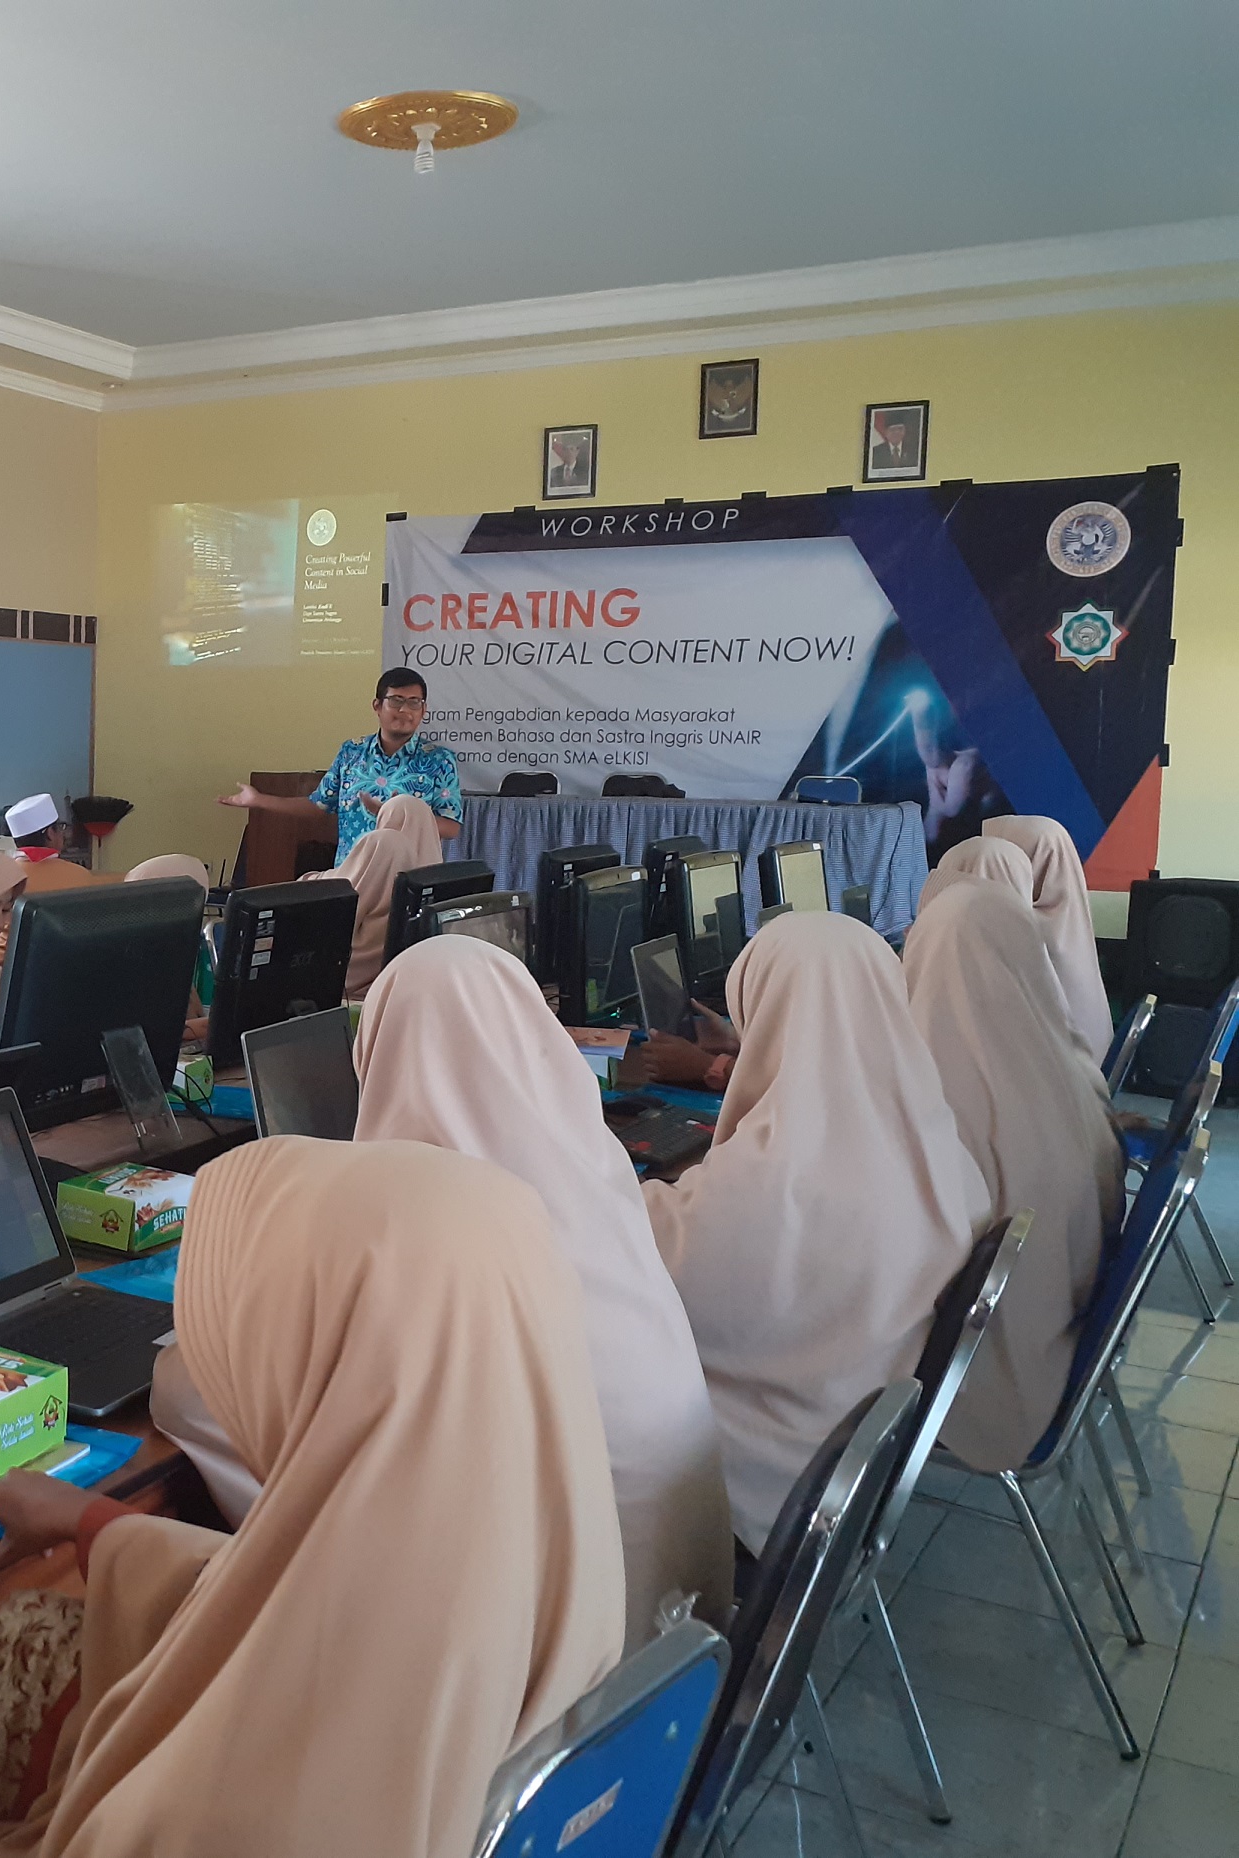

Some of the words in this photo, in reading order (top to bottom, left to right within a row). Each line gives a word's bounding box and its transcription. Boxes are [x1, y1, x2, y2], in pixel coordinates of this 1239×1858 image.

[540, 508, 740, 538] WORKSHOP
[305, 554, 338, 565] Creating
[339, 551, 371, 564] Powerful
[305, 567, 334, 577] Content
[336, 567, 344, 576] in
[345, 564, 368, 576] Social
[304, 579, 328, 590] Media
[403, 588, 641, 632] CREATING
[401, 642, 474, 668] YOUR
[483, 640, 594, 666] DIGITAL
[603, 638, 750, 665] CONTENT
[758, 635, 855, 663] NOW!
[422, 709, 461, 725] gram
[465, 707, 562, 725] Pengabdian
[565, 707, 630, 724] kepada
[635, 706, 736, 725] Masyarakat
[419, 729, 494, 744] partemen
[497, 729, 555, 743] Bahasa
[559, 729, 592, 743] dan
[596, 729, 645, 745] Sastra
[650, 730, 703, 748] Inggris
[708, 729, 762, 745] UNAIR
[497, 750, 559, 766] dengan
[563, 750, 599, 765] SMA
[603, 750, 649, 765] eLKISI
